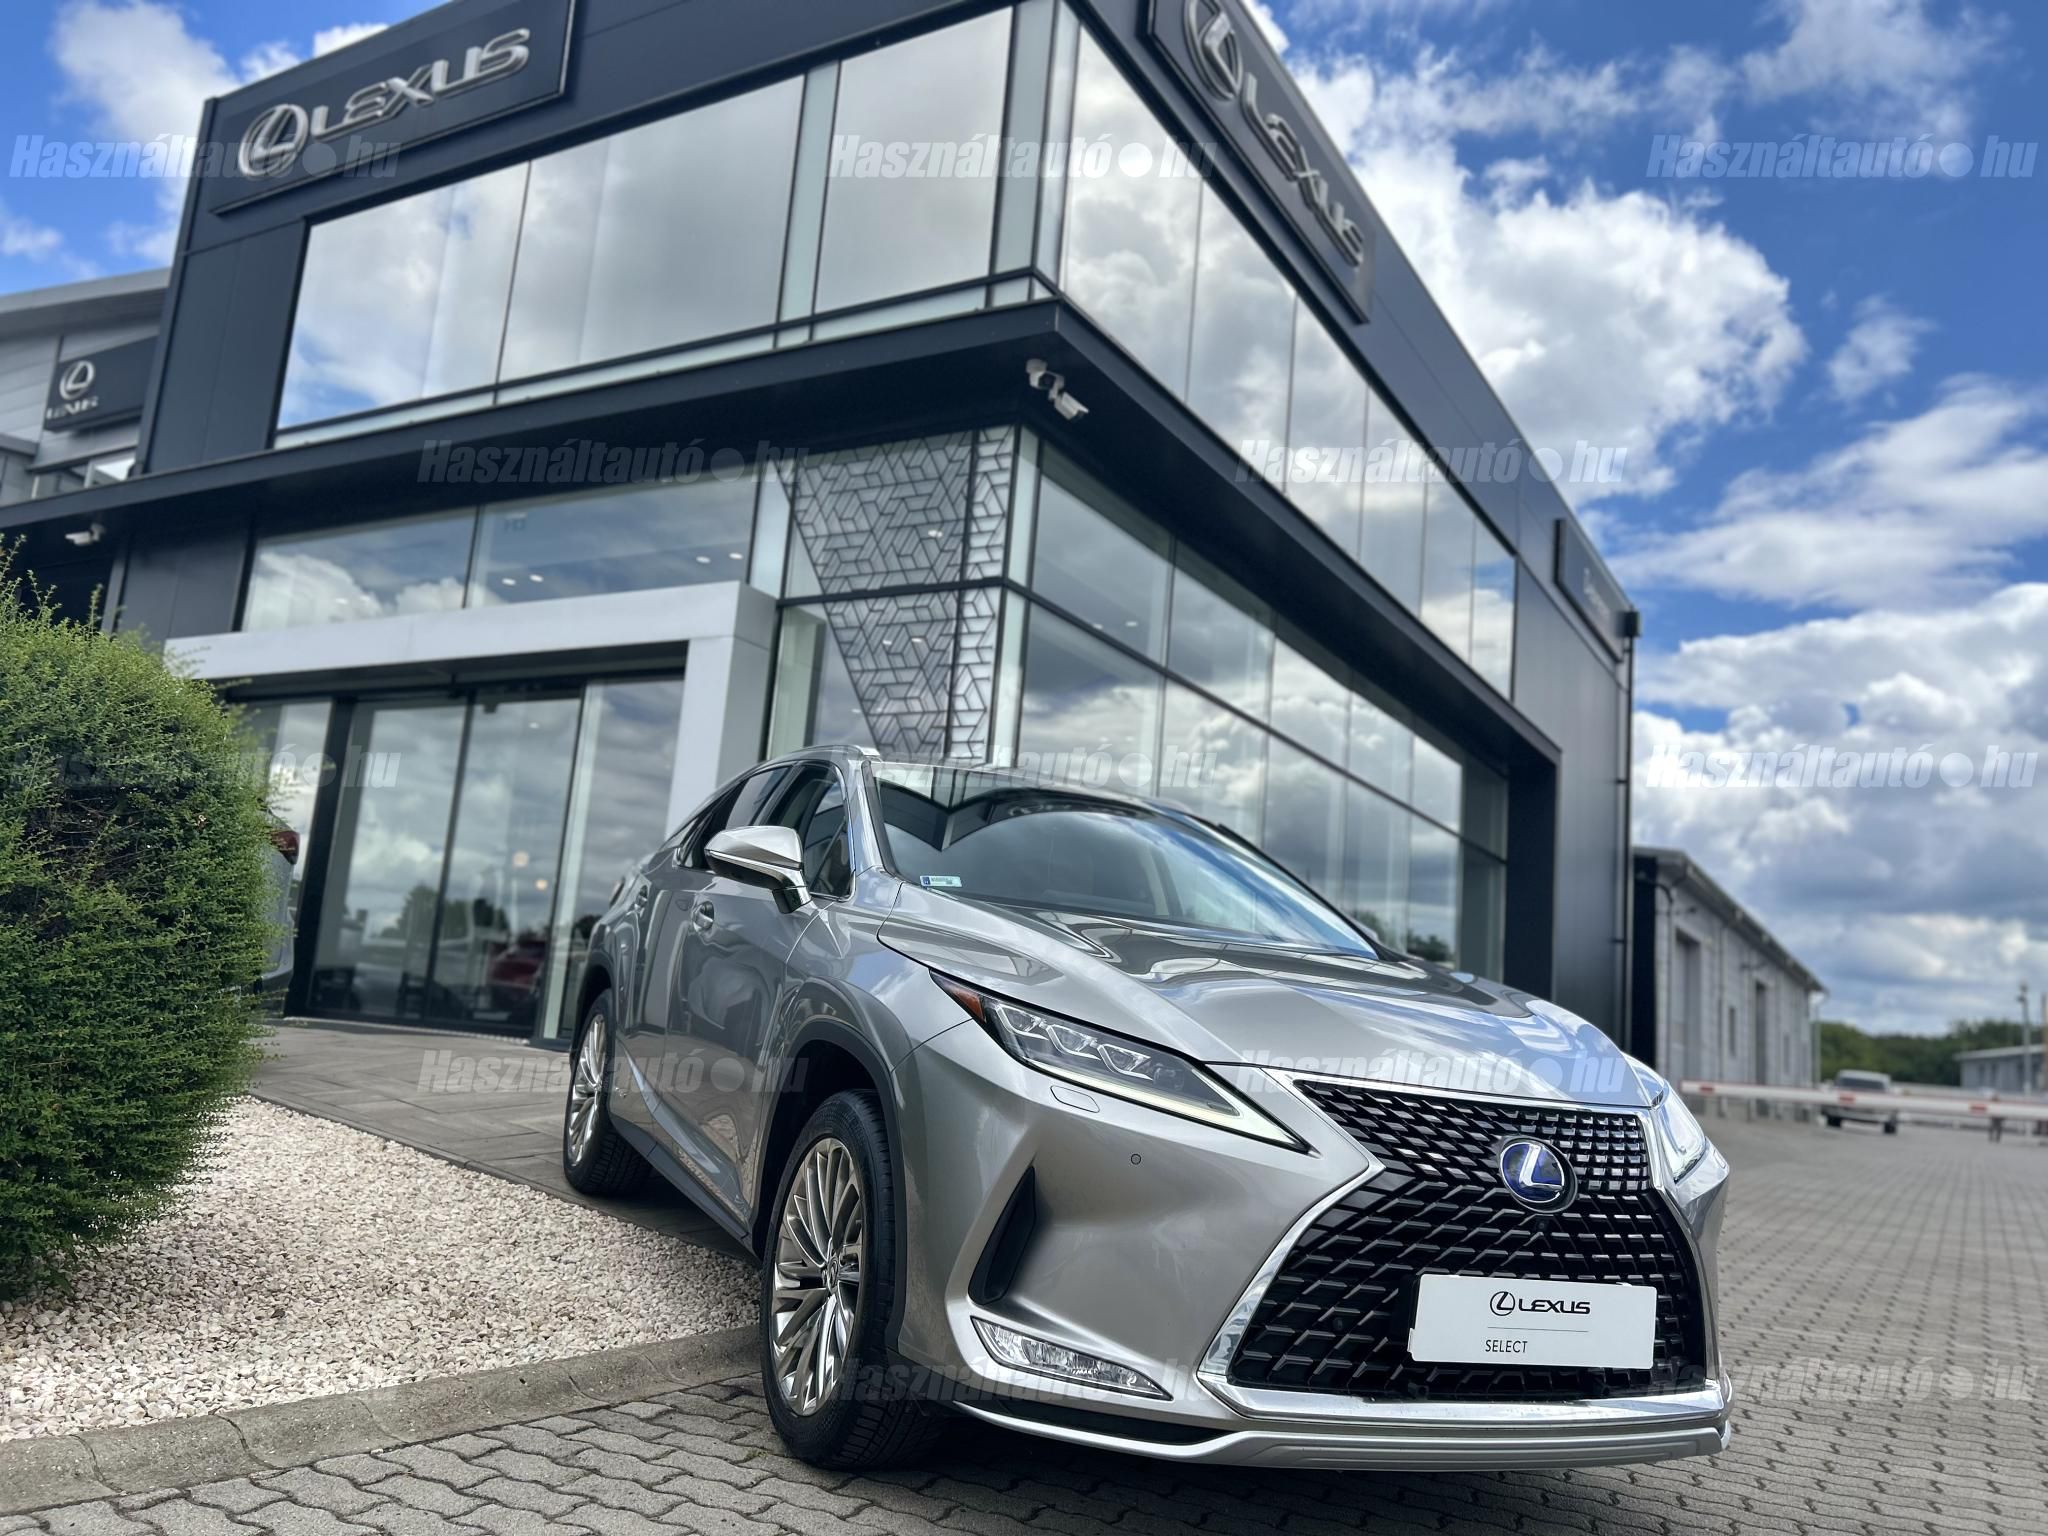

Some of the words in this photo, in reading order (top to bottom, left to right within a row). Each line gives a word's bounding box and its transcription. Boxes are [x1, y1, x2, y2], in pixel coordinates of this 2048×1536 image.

[311, 28, 530, 140] LEXUS
[1241, 72, 1364, 268] LEXUS
[1518, 1298, 1591, 1315] LEXUS
[1485, 1339, 1528, 1354] SELECT
